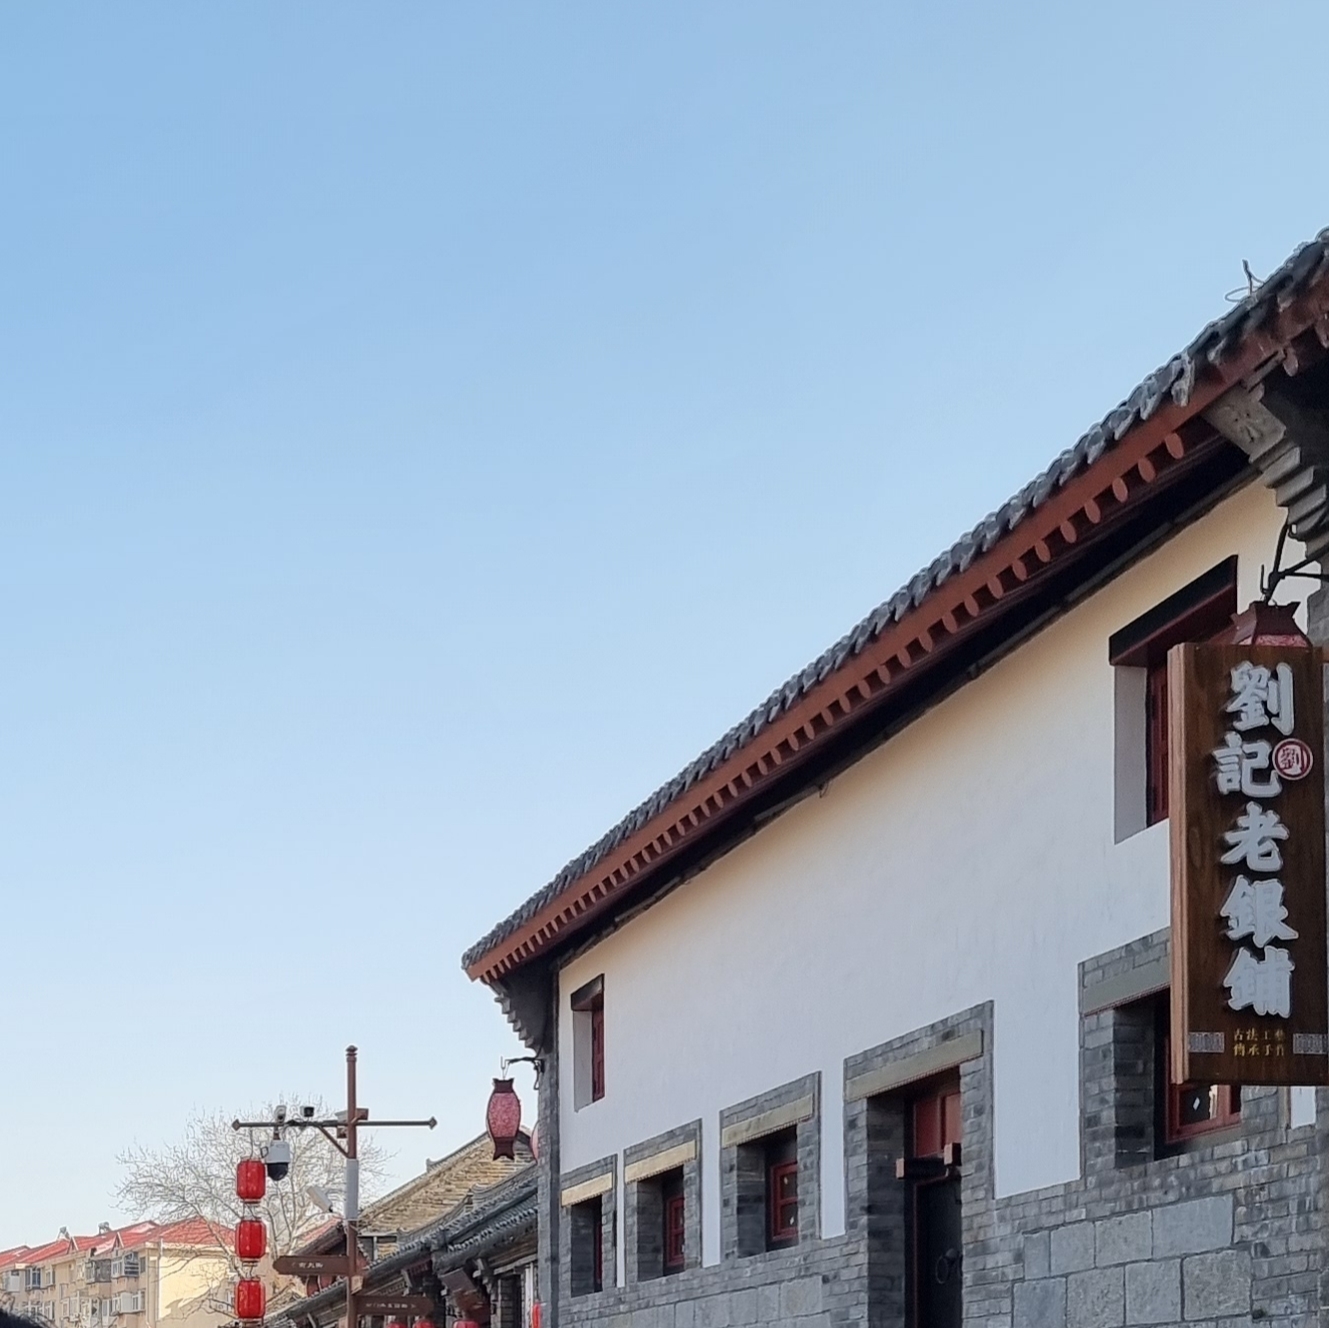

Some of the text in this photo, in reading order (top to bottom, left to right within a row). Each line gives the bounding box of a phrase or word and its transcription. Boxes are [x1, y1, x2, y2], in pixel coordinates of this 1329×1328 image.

[1213, 659, 1299, 1019] 劉記老銀鋪
